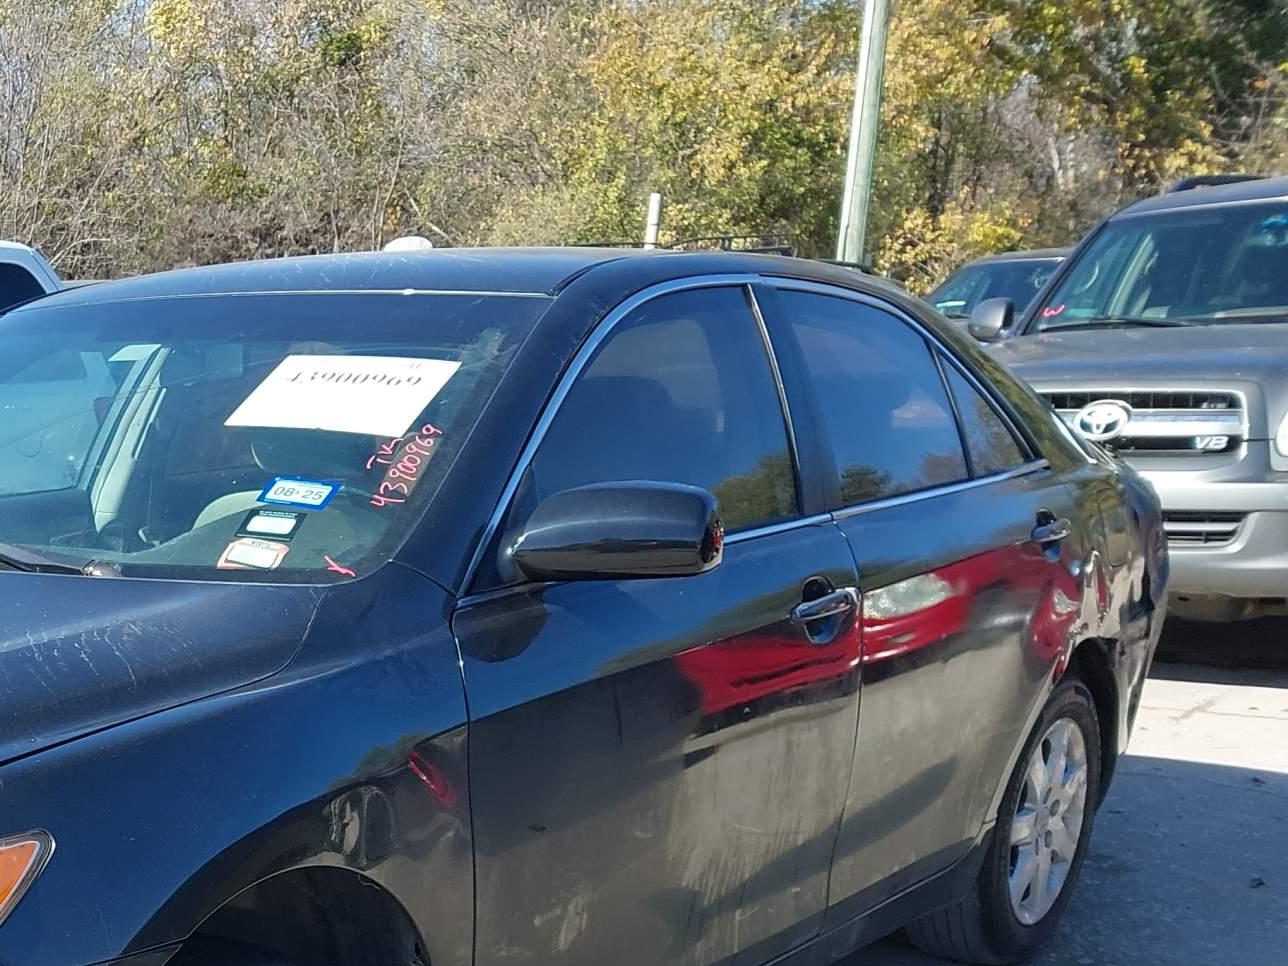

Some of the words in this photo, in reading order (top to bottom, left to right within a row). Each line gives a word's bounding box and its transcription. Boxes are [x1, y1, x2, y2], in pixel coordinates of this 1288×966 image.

[1195, 435, 1229, 450] V8
[369, 423, 443, 507] 43900969
[273, 486, 296, 497] 08
[301, 490, 324, 501] 25
